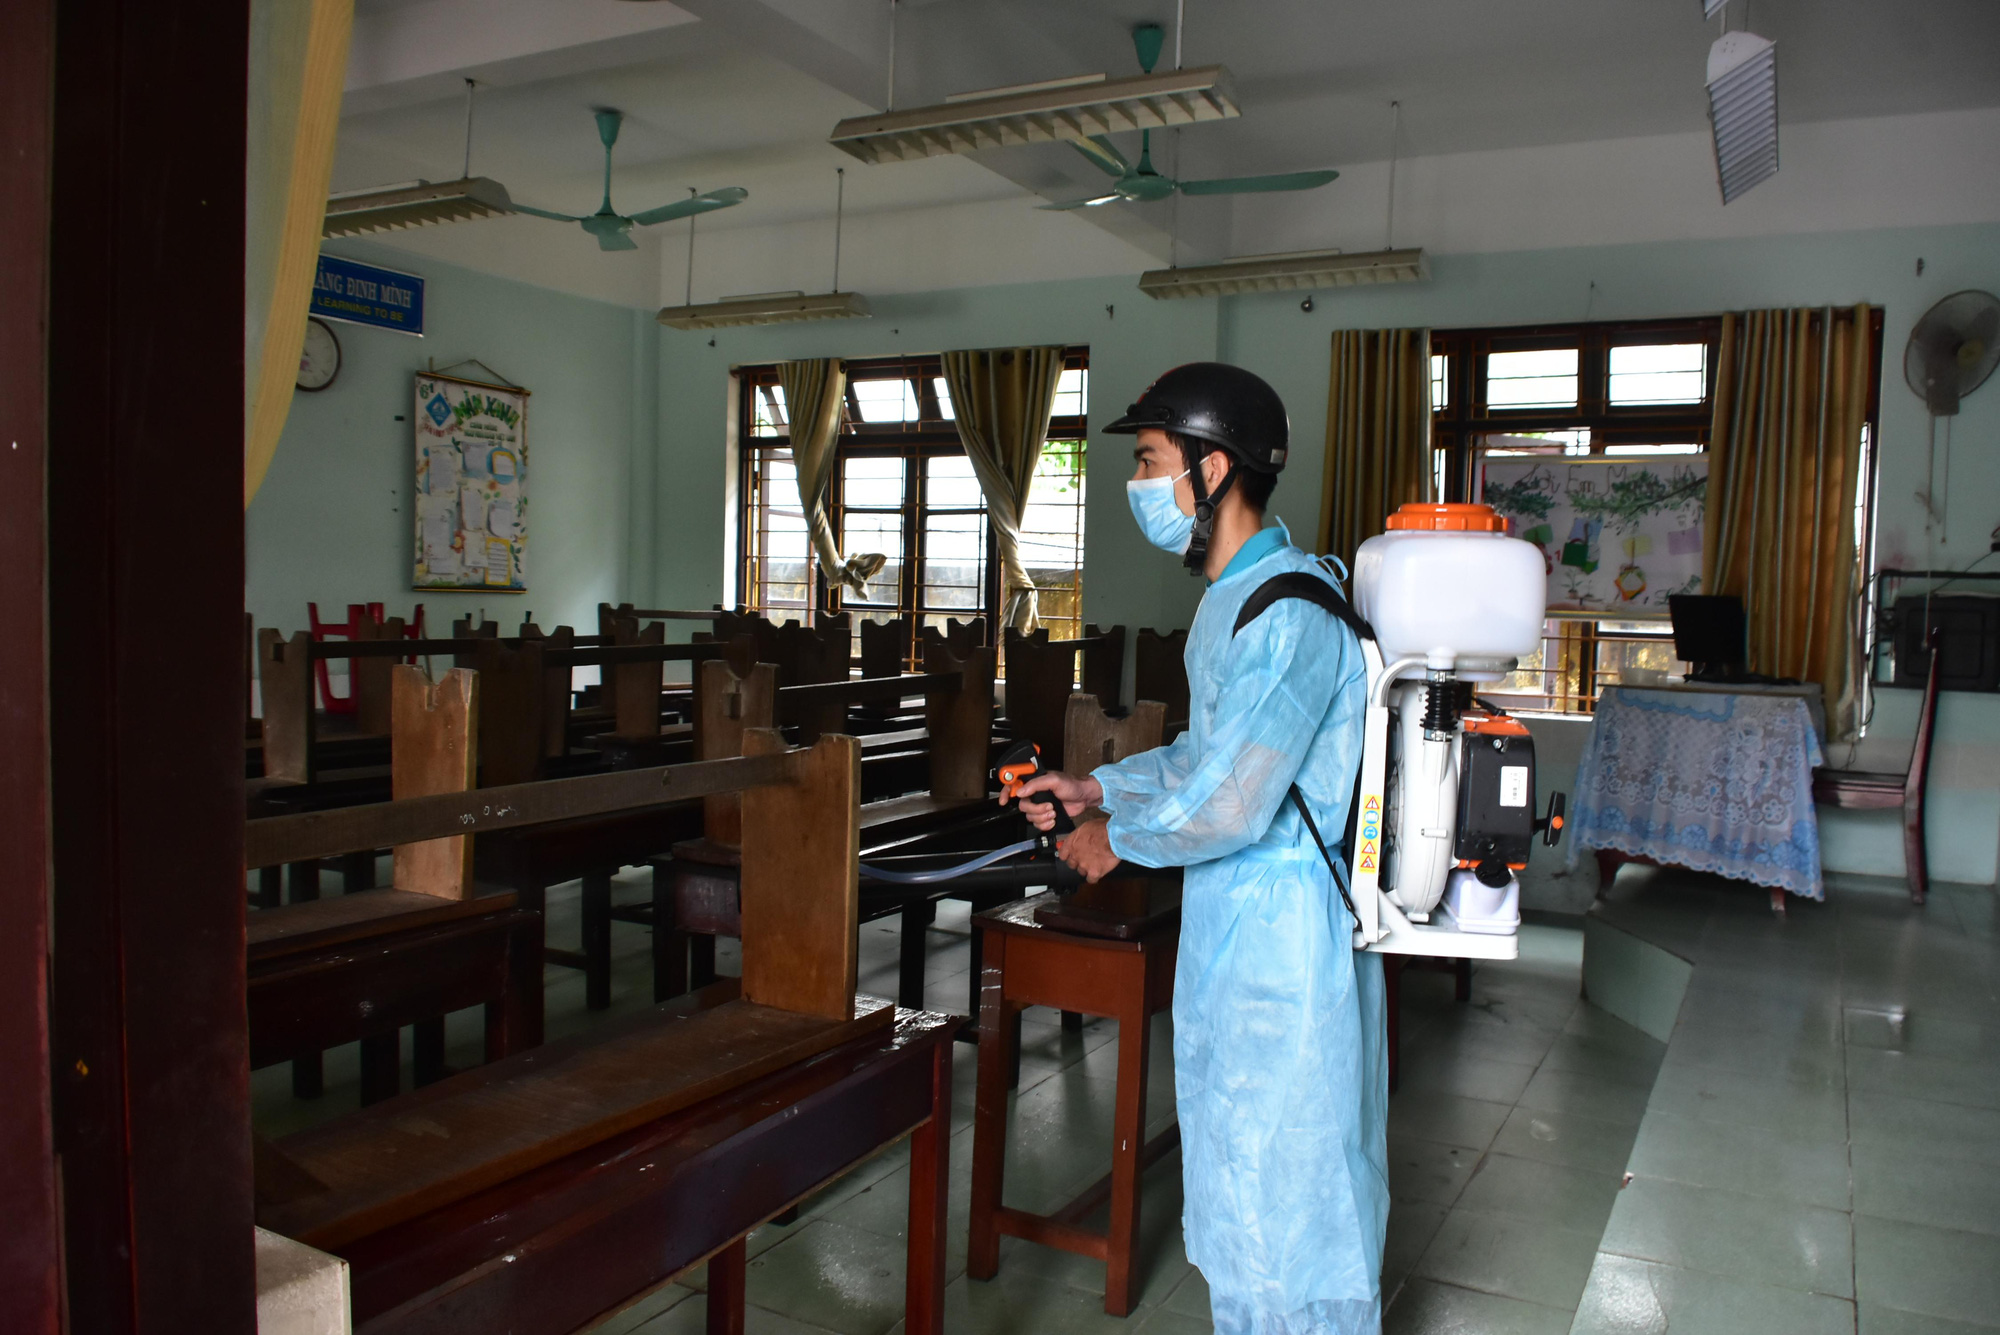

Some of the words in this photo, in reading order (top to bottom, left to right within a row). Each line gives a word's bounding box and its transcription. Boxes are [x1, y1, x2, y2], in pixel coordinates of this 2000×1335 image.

[380, 281, 412, 308] MÌNH
[317, 296, 372, 316] LEARNING
[374, 307, 388, 319] TO
[390, 310, 404, 322] BE
